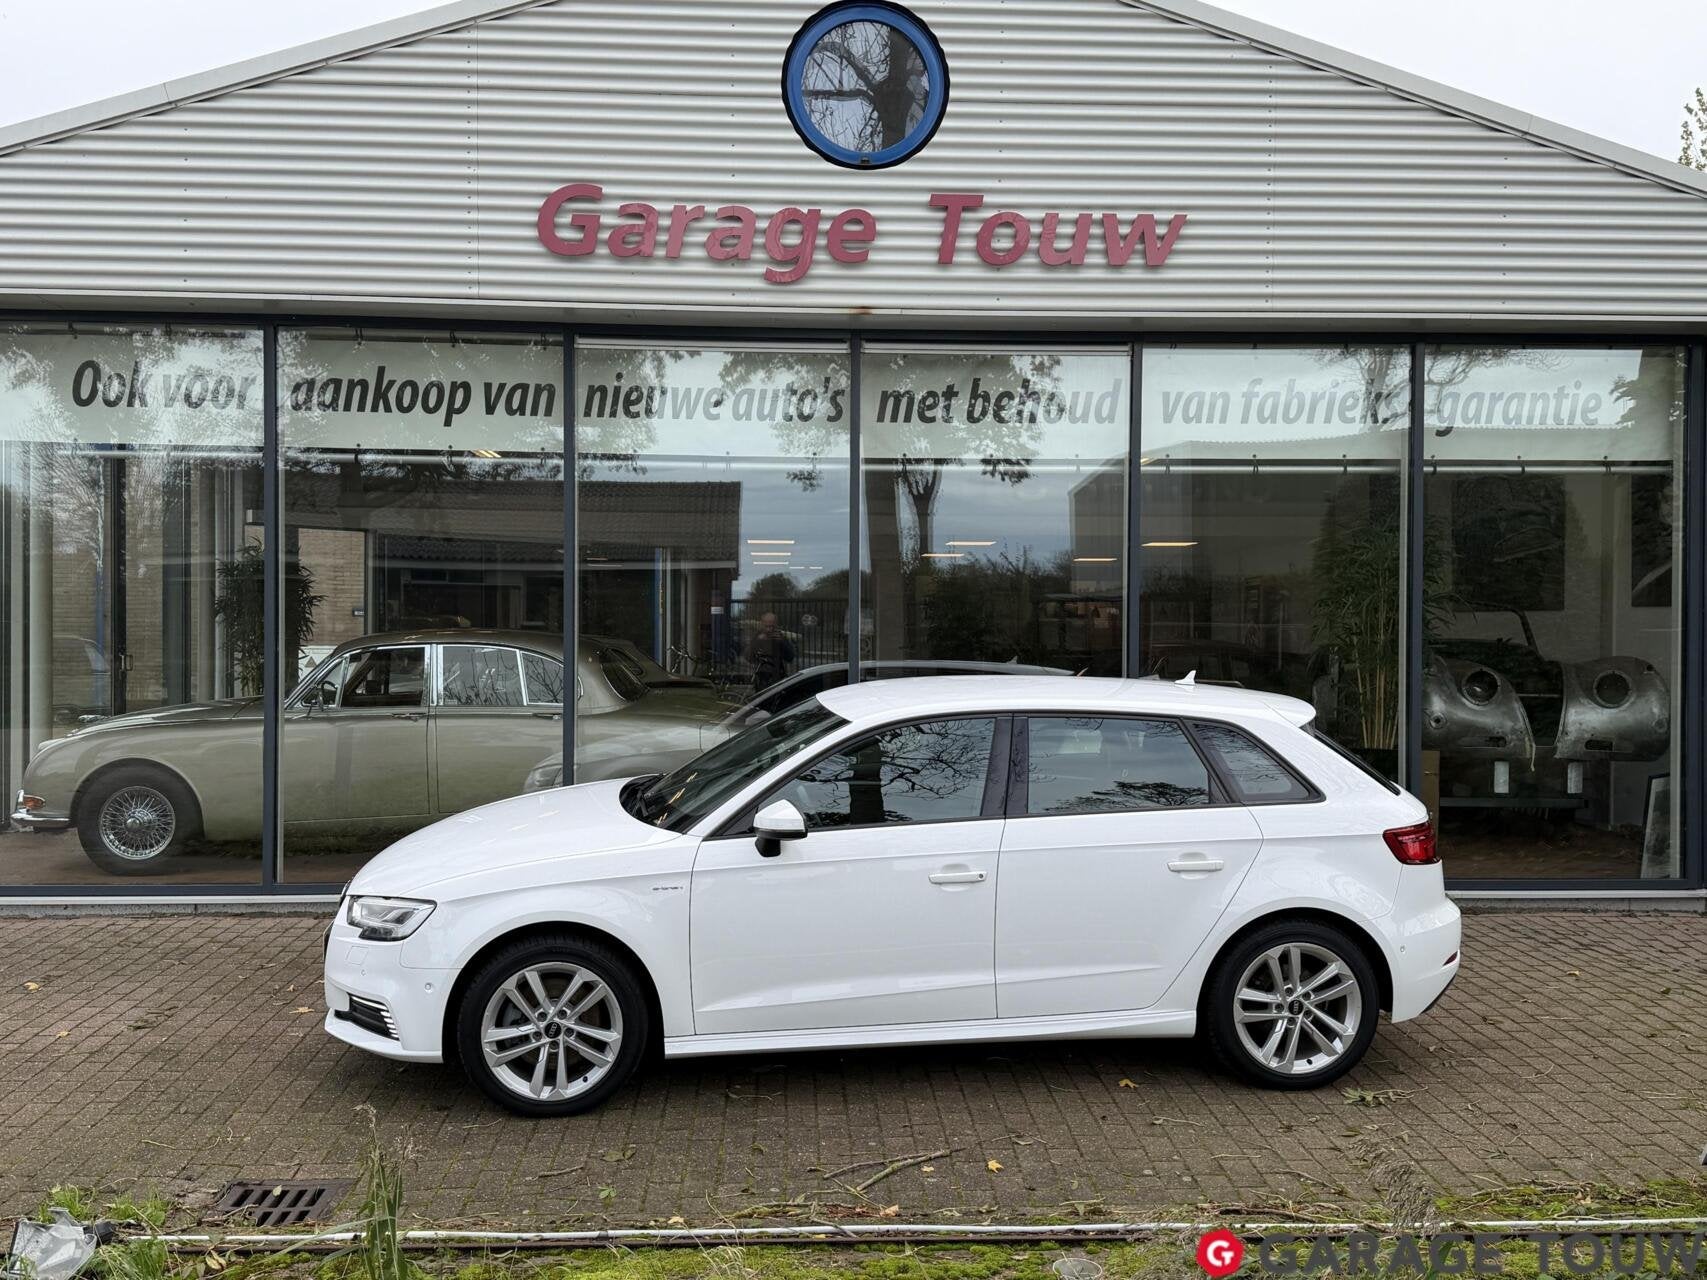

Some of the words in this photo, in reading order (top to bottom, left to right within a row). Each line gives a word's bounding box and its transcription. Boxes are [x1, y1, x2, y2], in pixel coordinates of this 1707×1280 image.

[536, 183, 877, 284] Garage
[928, 193, 1188, 267] Touw
[72, 359, 152, 408] Ook
[162, 373, 256, 410] voor
[290, 365, 473, 427] aankoop
[484, 381, 557, 418] van
[583, 371, 723, 421] nieuwe
[732, 376, 846, 423] auto's
[876, 381, 959, 425] met
[967, 377, 1122, 426] behoud
[1162, 386, 1233, 425] van
[1434, 379, 1602, 437] garantie
